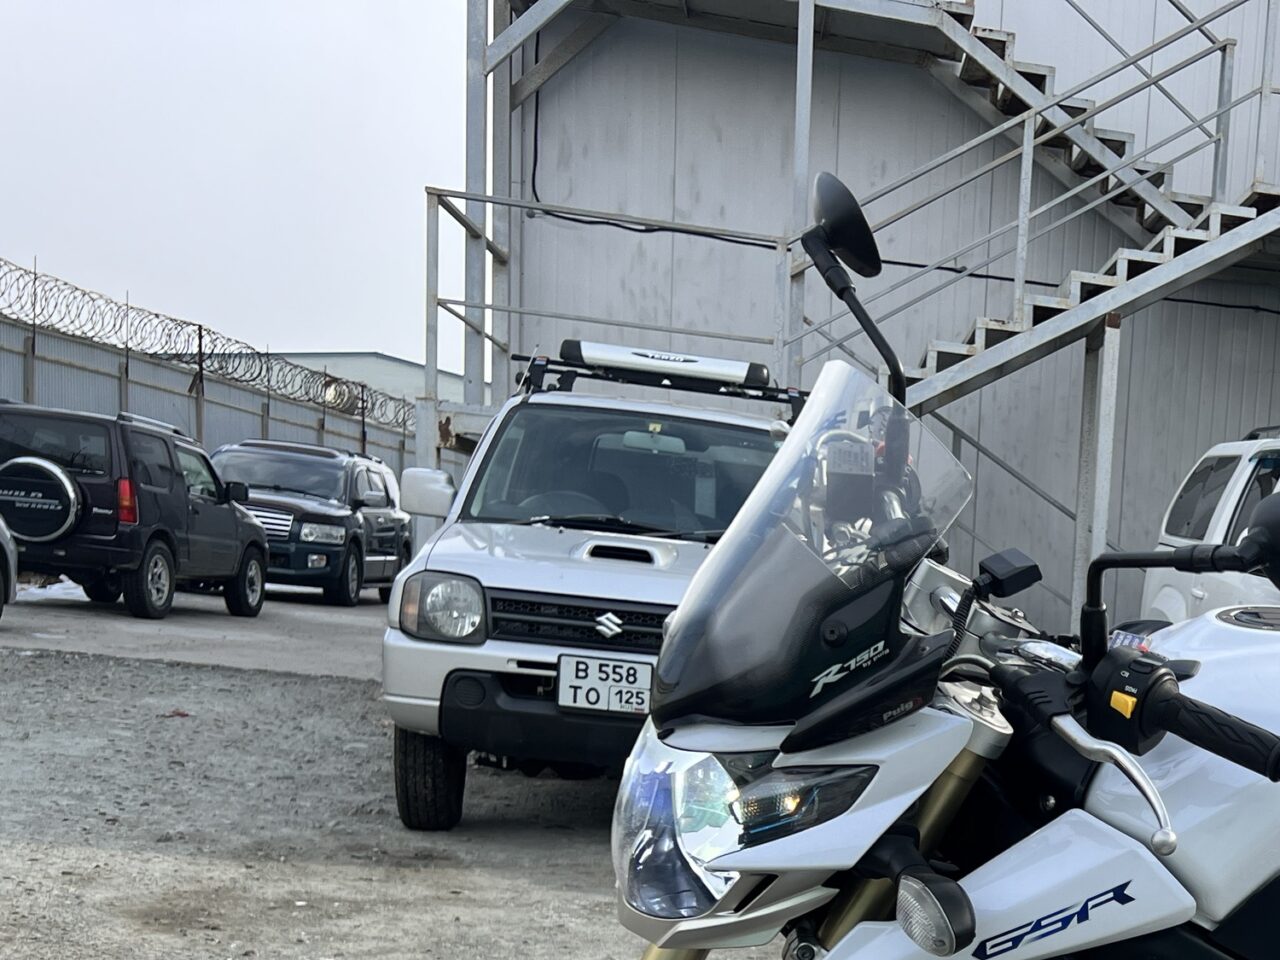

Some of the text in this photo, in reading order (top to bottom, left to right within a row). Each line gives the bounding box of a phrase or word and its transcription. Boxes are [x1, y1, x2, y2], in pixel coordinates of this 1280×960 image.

[575, 660, 638, 685] B 558
[568, 684, 600, 705] TO
[614, 689, 646, 706] 125
[971, 878, 1136, 960] GSR
